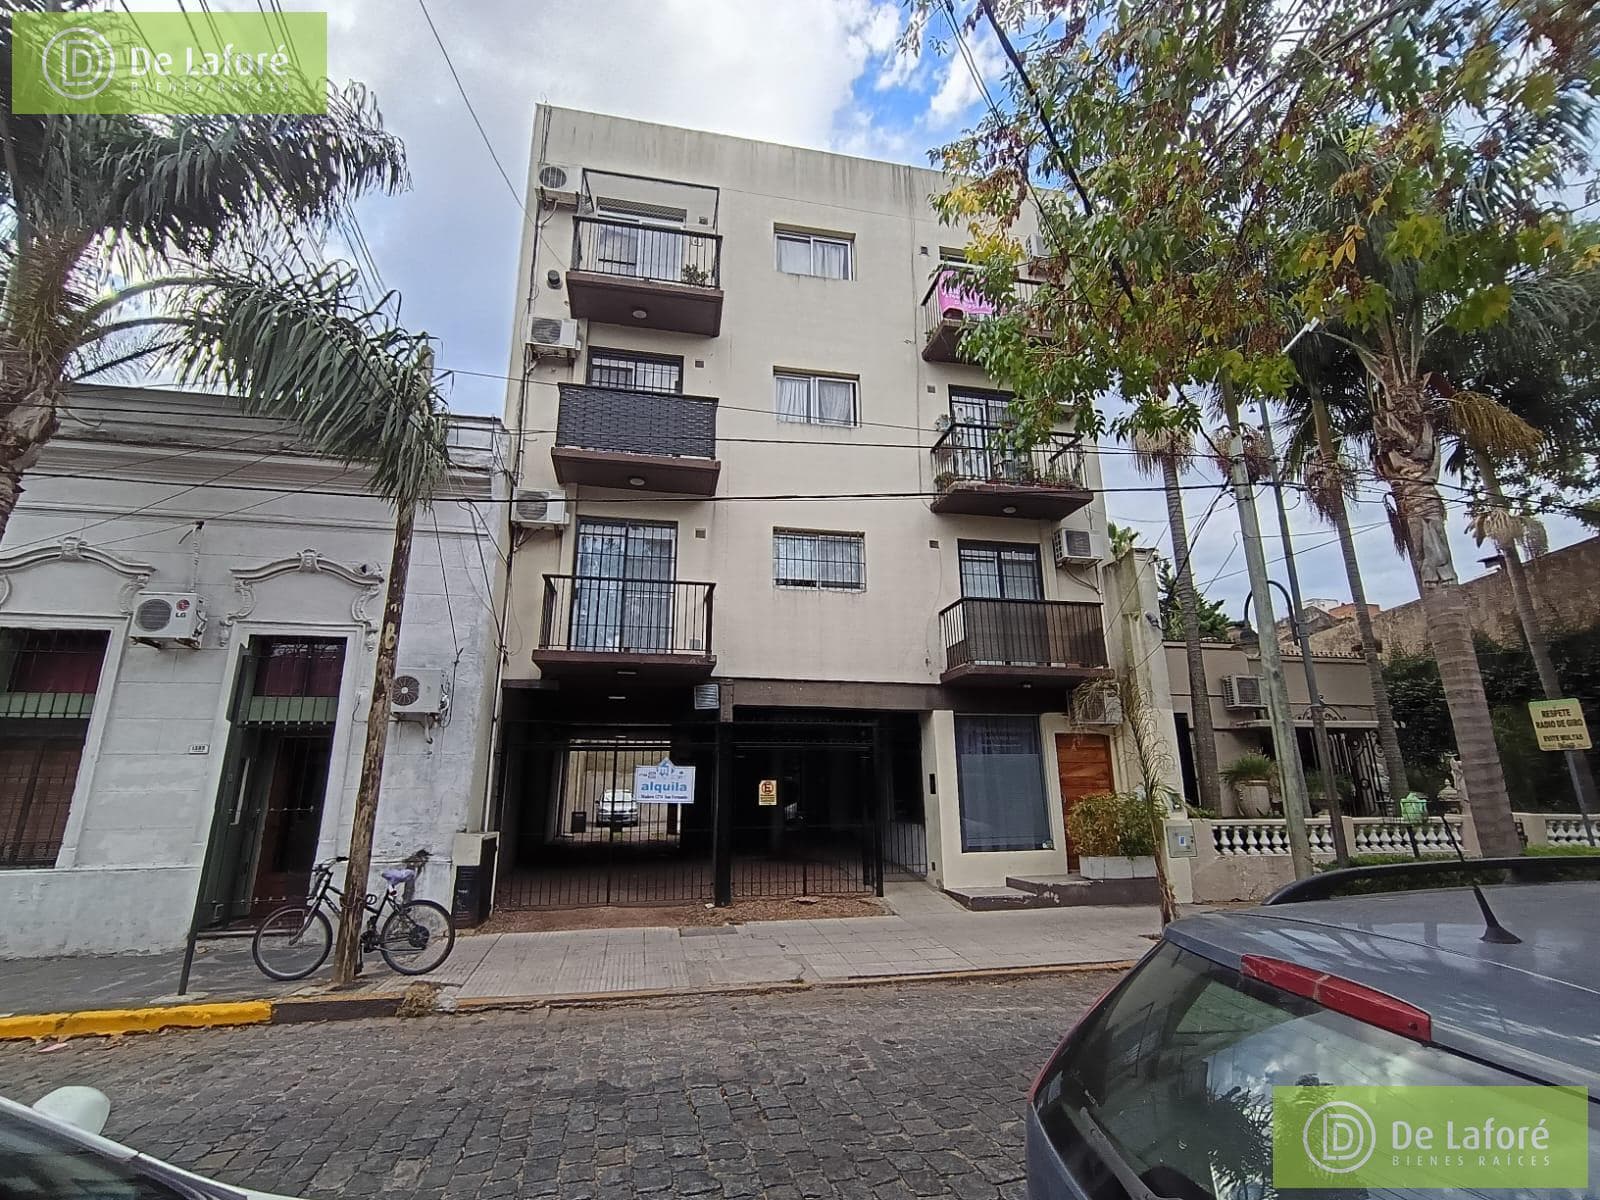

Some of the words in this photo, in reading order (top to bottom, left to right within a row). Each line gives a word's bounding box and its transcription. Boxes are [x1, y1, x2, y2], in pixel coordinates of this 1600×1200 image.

[1541, 708, 1571, 718] RESPETE
[1535, 720, 1556, 729] RADIO
[1556, 719, 1566, 728] DE
[641, 781, 687, 794] alquila
